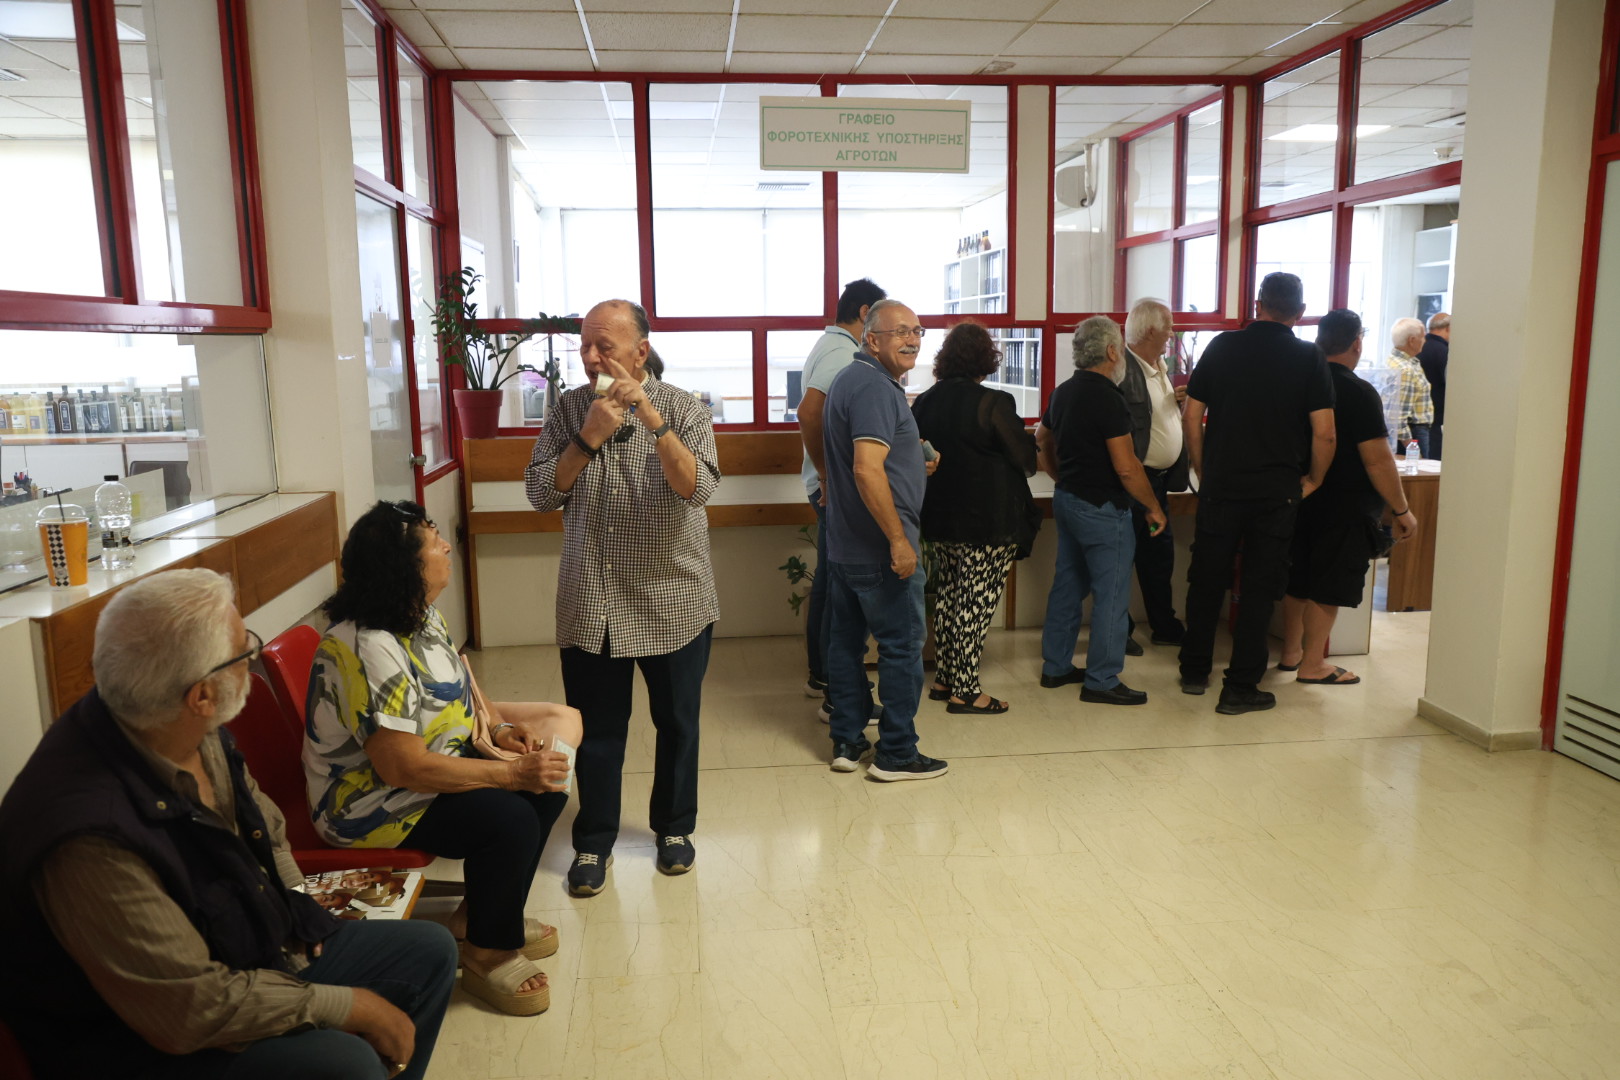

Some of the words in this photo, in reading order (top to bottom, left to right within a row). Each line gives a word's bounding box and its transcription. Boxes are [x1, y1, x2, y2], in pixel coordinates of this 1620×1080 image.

[839, 113, 895, 126] ΓΡΑΦΕΙΟ
[767, 130, 870, 143] ΦΟΡΟΤΕΧΝΙΚΗΣ
[876, 132, 964, 146] ΥΠΟΣΤΗΡΙΞΗΣ
[835, 150, 897, 162] ΑΓΡΟΤΩΝ
